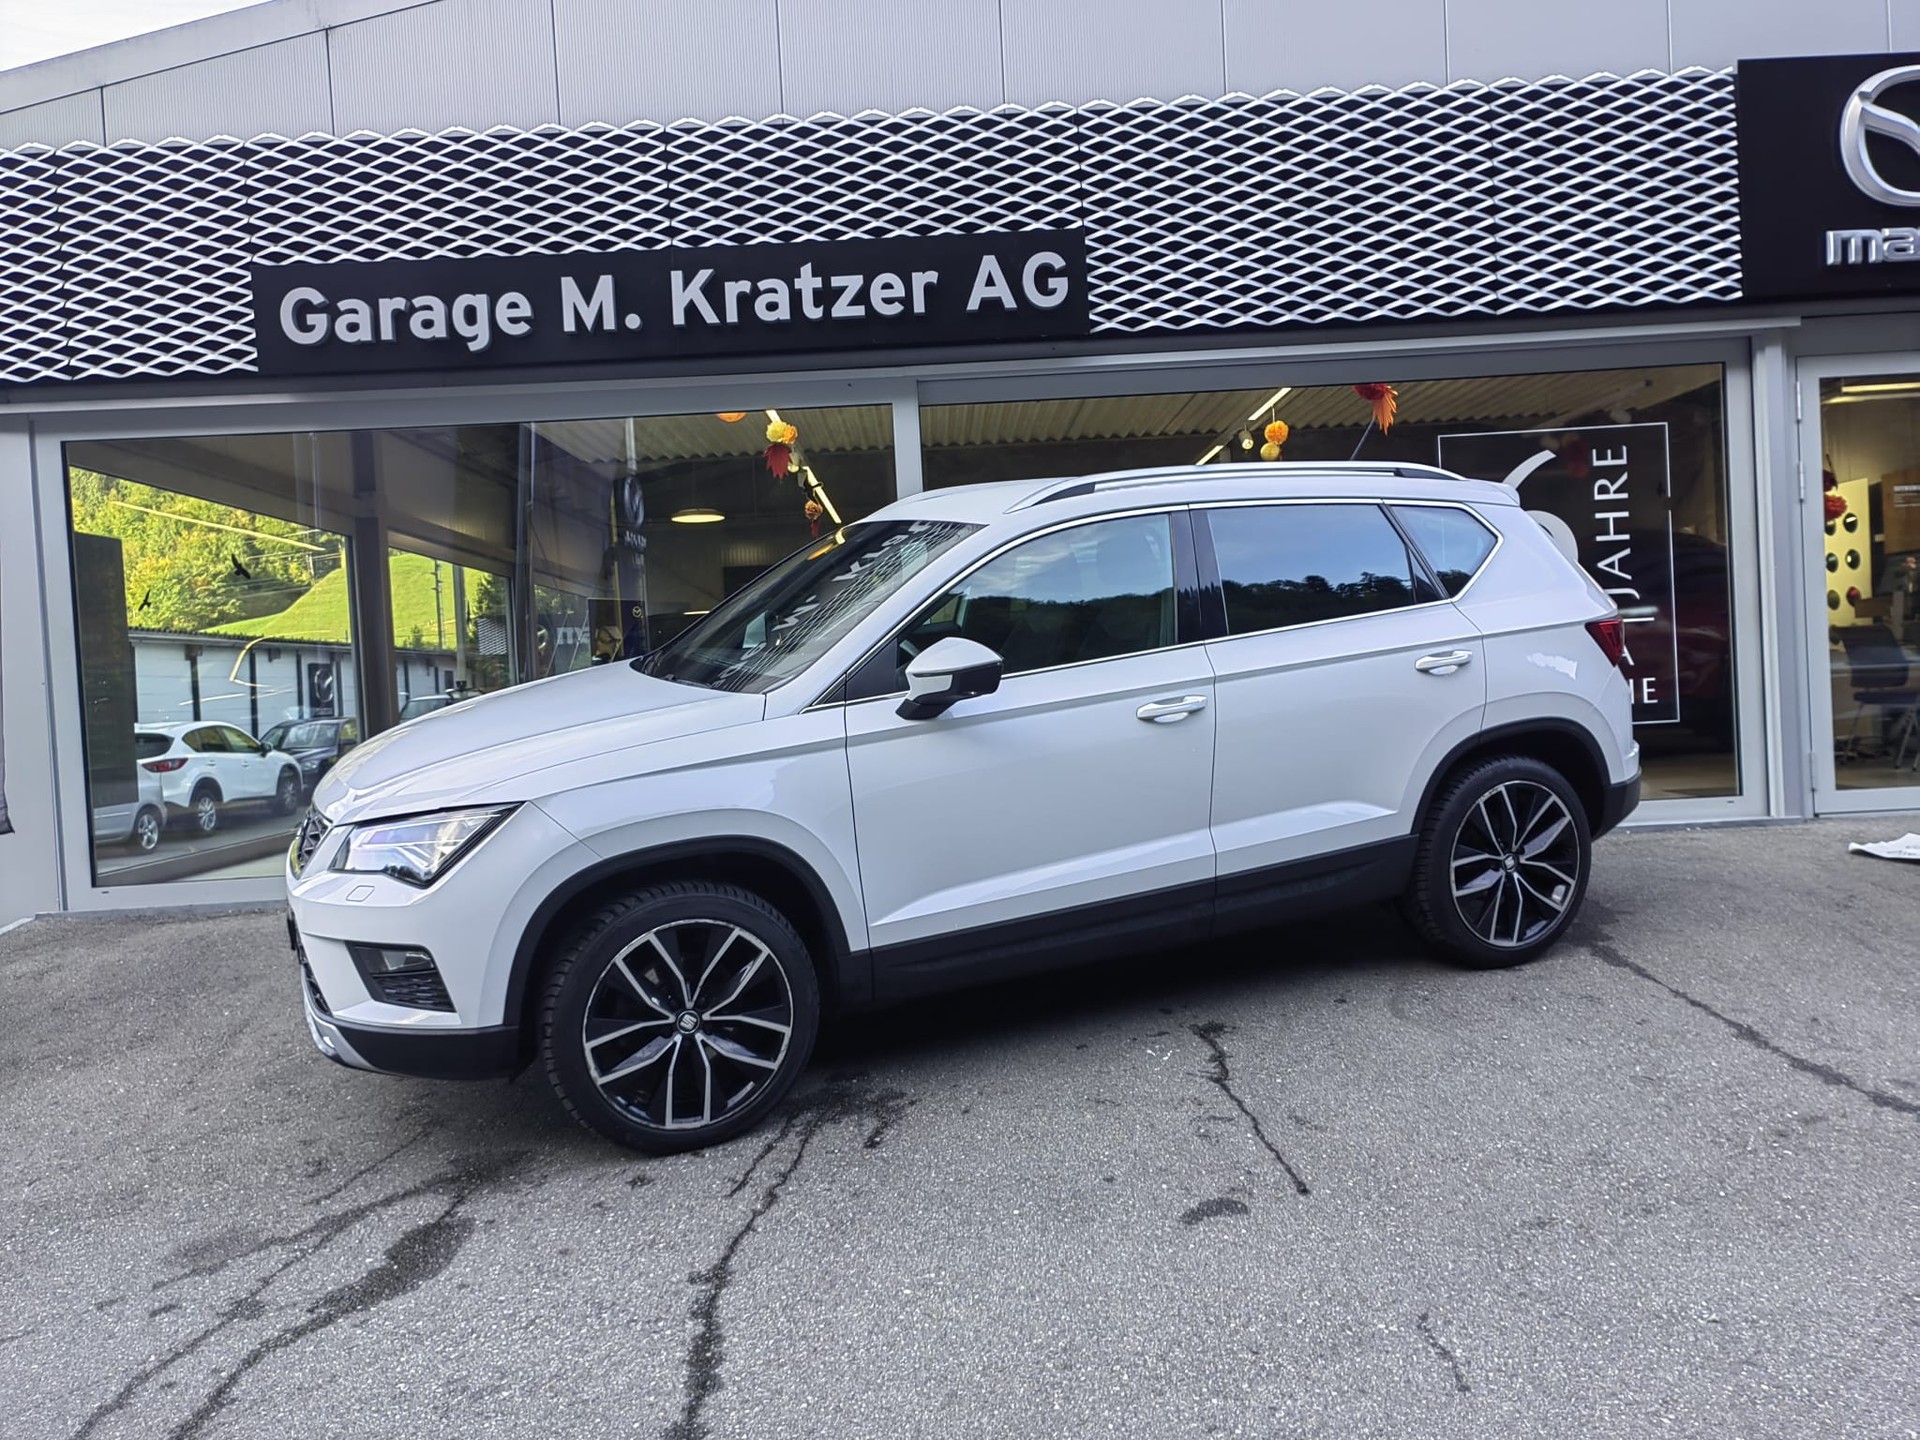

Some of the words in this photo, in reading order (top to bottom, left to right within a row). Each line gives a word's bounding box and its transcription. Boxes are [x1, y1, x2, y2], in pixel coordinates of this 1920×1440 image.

[1826, 227, 1920, 265] ma
[280, 286, 533, 352] Garage
[560, 275, 641, 333] M.
[670, 262, 940, 327] Kratzer
[966, 251, 1070, 311] AG
[1592, 445, 1641, 600] JAHRE
